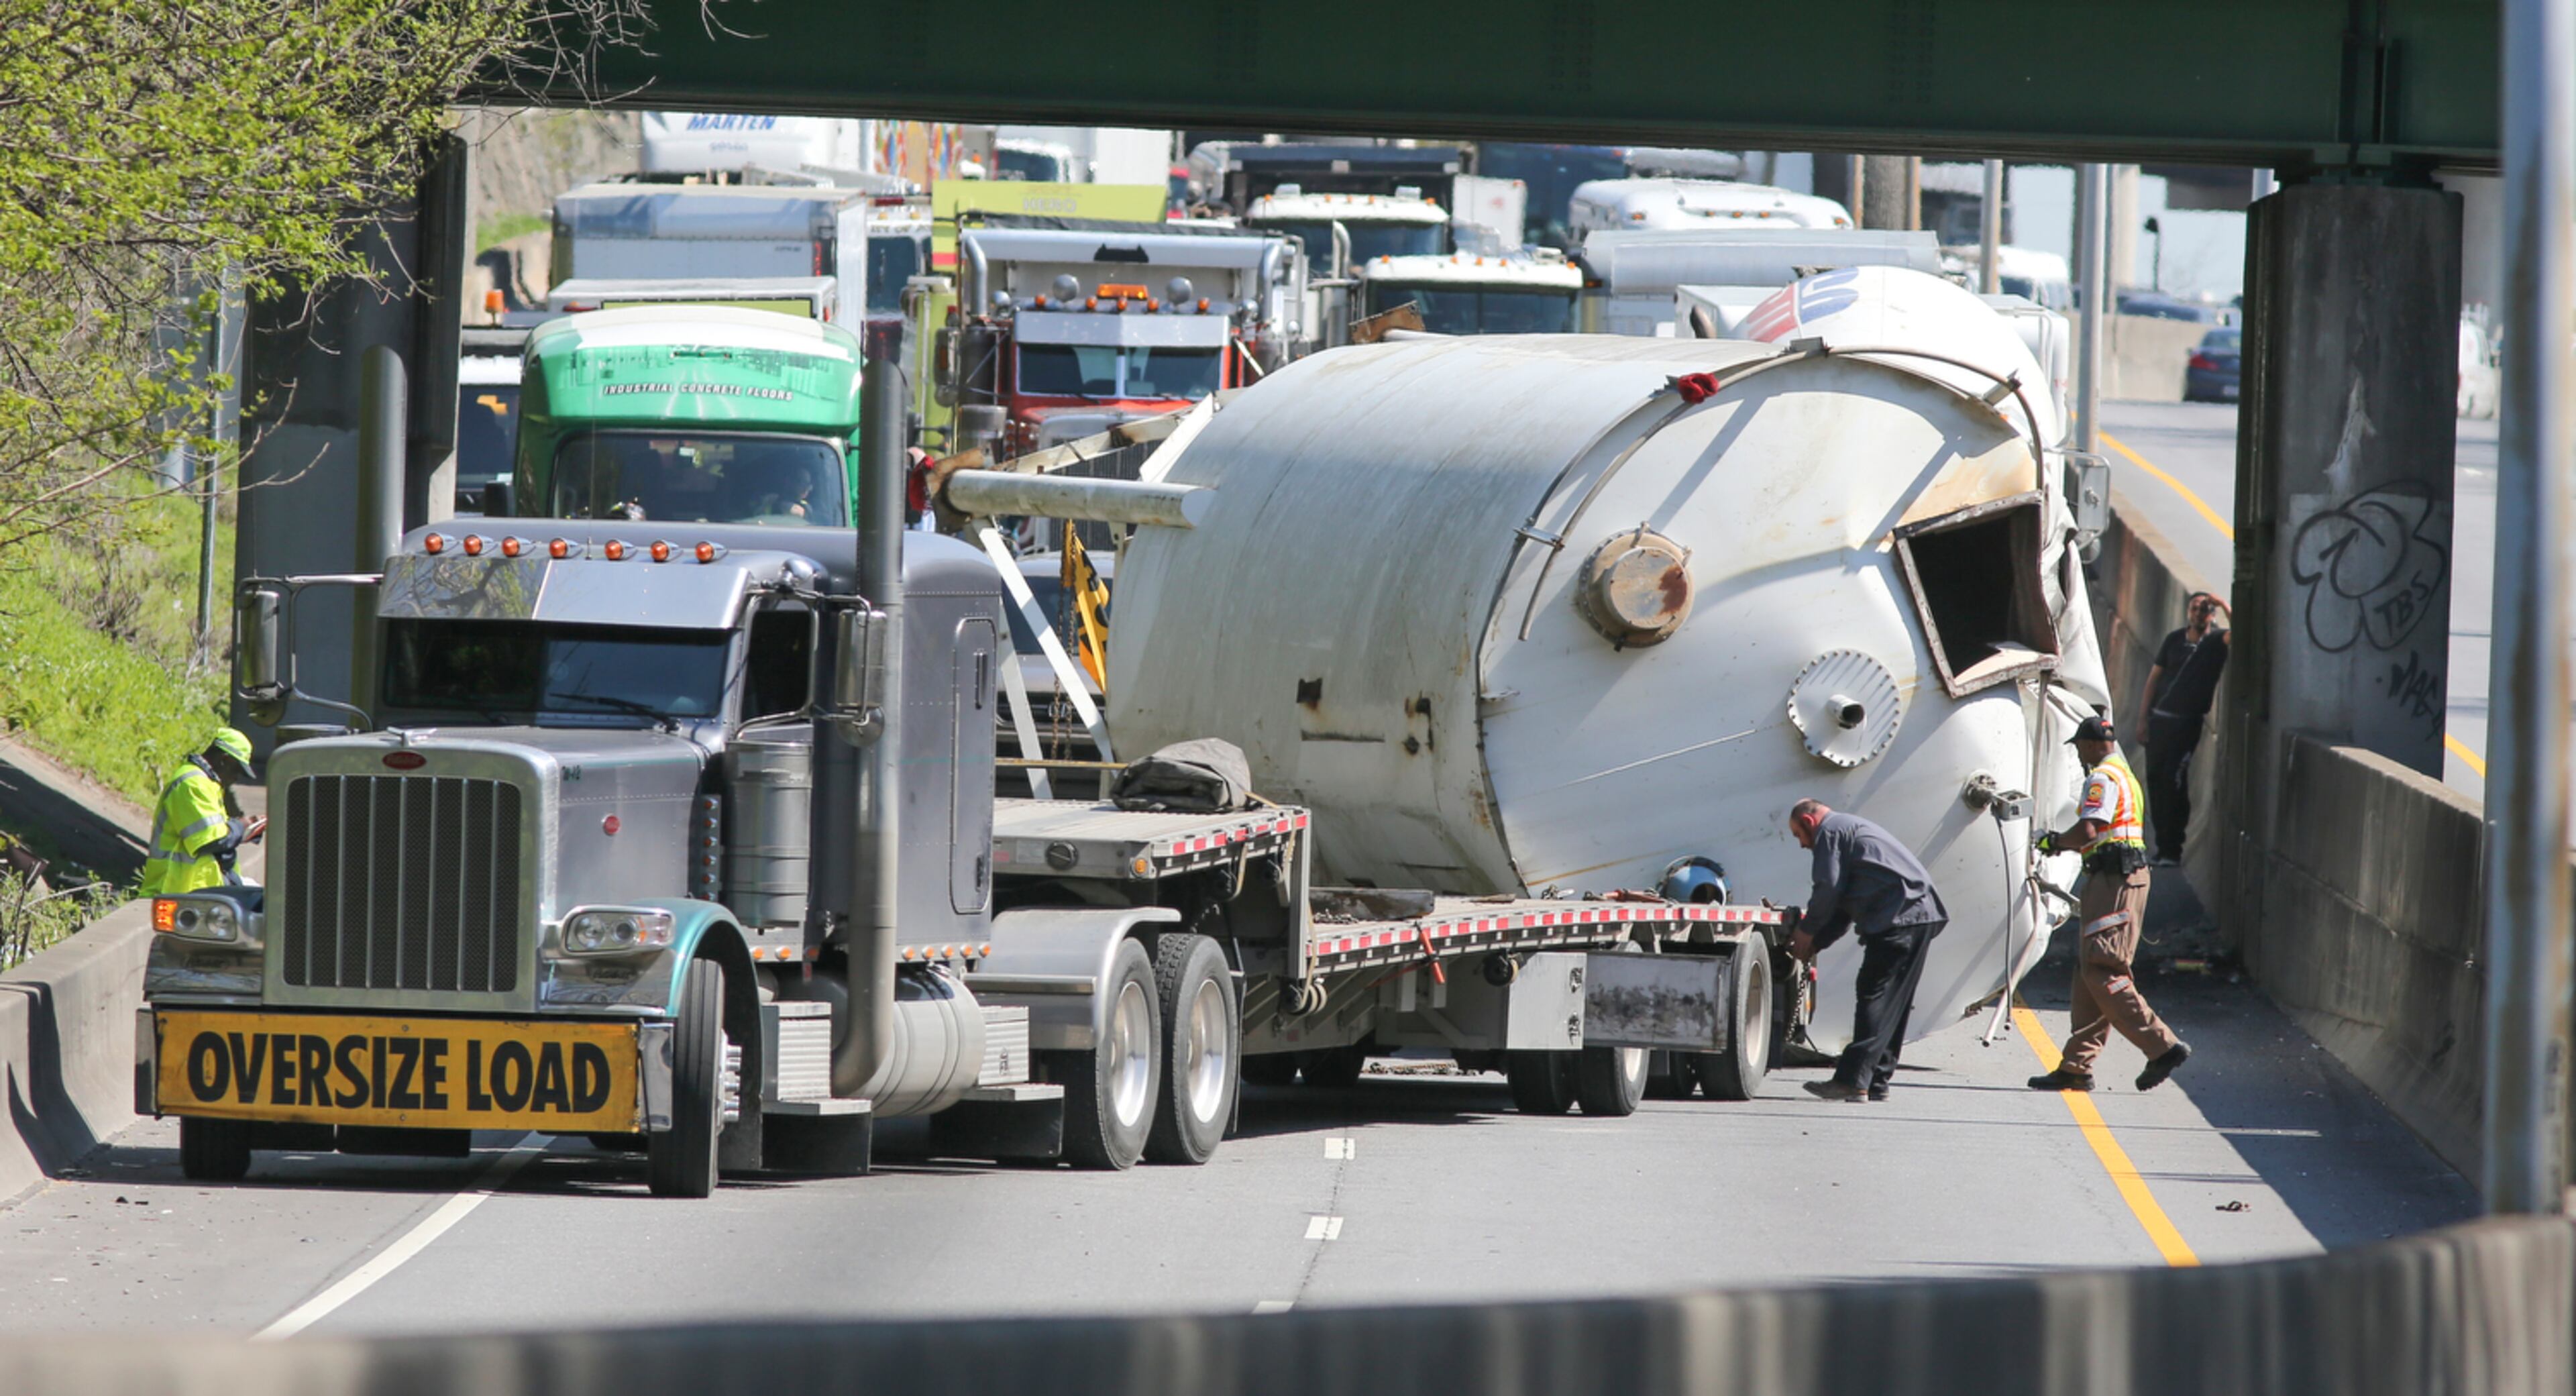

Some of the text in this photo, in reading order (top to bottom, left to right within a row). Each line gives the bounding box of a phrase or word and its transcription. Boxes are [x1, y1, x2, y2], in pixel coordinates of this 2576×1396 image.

[1023, 198, 1077, 213] HERO
[603, 382, 794, 401] INDUSTRIAL CONCRETE FLOORS
[2373, 569, 2430, 637] TBS
[186, 1030, 612, 1114] OVERSIZE LOAD
